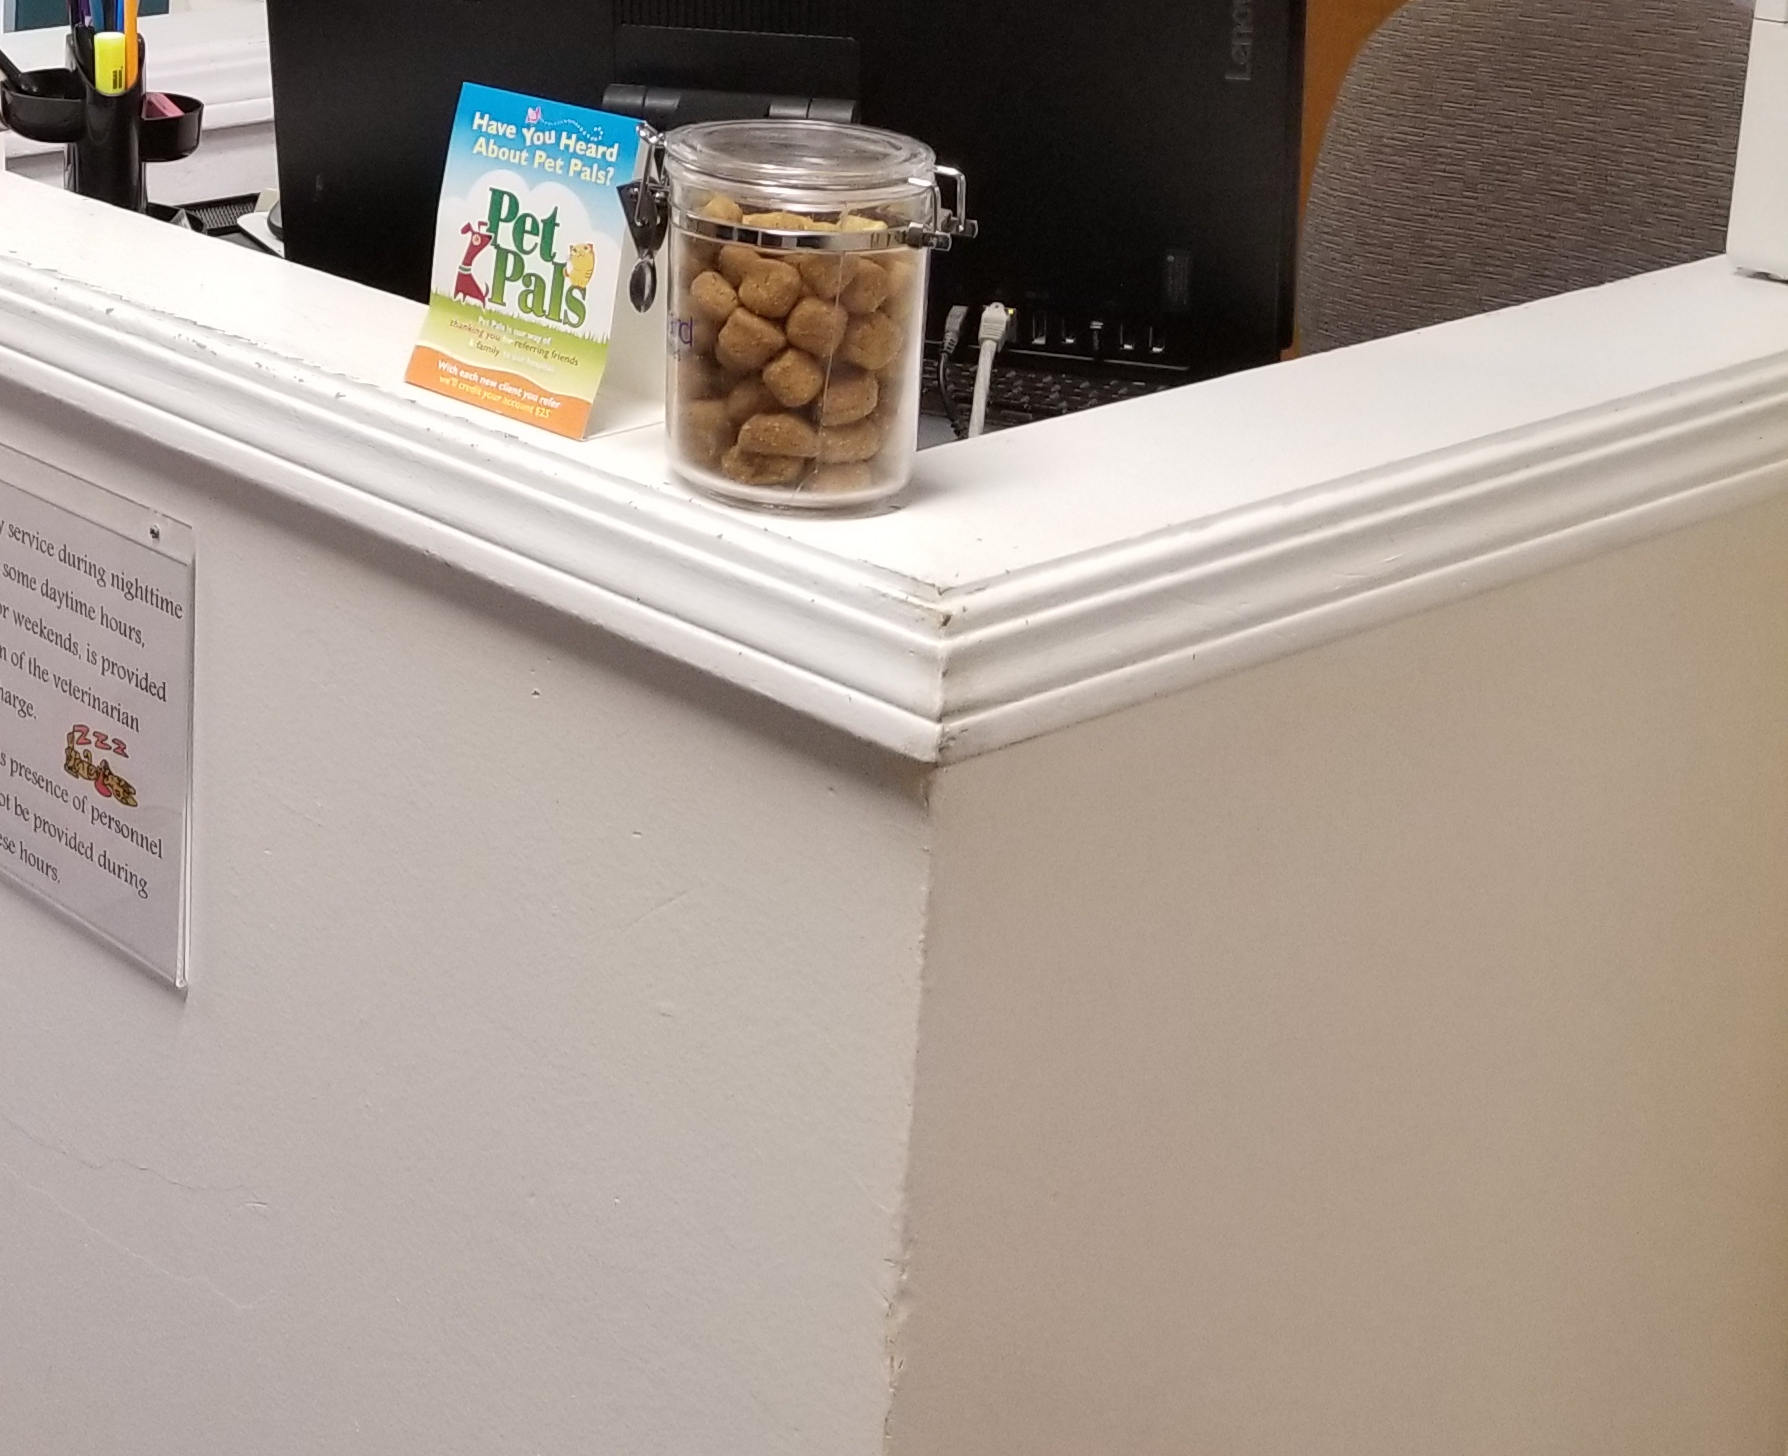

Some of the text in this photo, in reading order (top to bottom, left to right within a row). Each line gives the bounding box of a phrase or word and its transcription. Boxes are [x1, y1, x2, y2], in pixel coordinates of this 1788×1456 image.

[472, 111, 620, 163] Have You Heard
[472, 136, 615, 187] About Pet Pals?
[487, 186, 561, 264] Pet
[487, 243, 588, 330] Pals
[449, 319, 485, 338] thanking
[485, 331, 501, 342] you
[513, 339, 550, 359] referring
[551, 348, 579, 366] friends
[475, 340, 501, 357] family
[438, 359, 561, 410] With each new client you refer
[457, 381, 482, 396] credit
[482, 390, 503, 402] your
[502, 397, 534, 414] account
[534, 406, 551, 419] $25
[3, 565, 37, 592] some
[40, 572, 97, 622] daytime
[100, 605, 146, 649] hours,
[8, 523, 55, 557] service
[58, 542, 107, 588] during
[110, 571, 183, 620] nighttime
[11, 646, 26, 670] of
[28, 656, 50, 684] the
[52, 669, 141, 733] veterinarian
[13, 608, 83, 660] weekends,
[86, 641, 98, 667] is
[100, 653, 167, 703] provided
[9, 758, 69, 803] presence
[72, 791, 89, 814] of
[91, 804, 164, 859] personnel
[14, 796, 30, 822] be
[33, 812, 95, 862] provided
[97, 849, 149, 900] during
[19, 840, 61, 884] hours.
